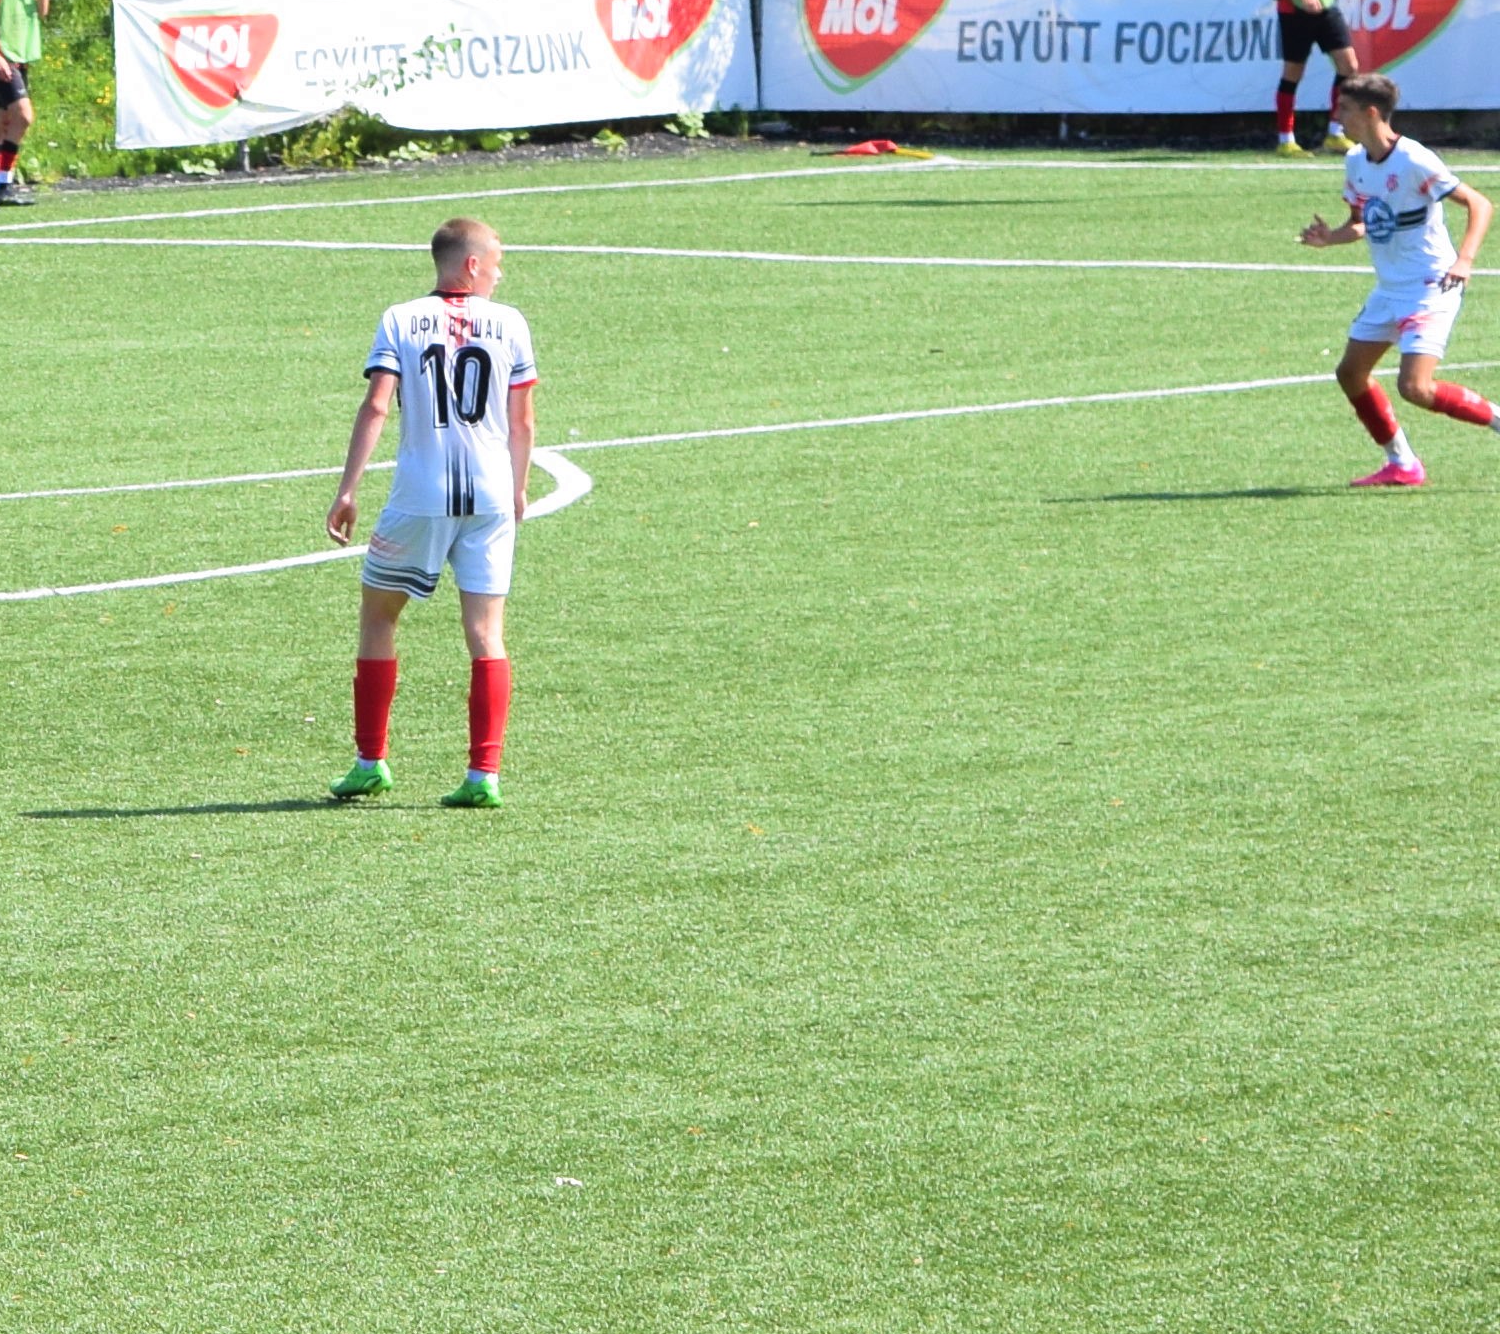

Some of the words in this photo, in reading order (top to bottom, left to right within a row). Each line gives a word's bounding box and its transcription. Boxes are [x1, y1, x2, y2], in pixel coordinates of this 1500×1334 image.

[174, 23, 251, 69] MOL
[957, 10, 1101, 64] EGYÜTT
[1113, 18, 1284, 64] FOCIZUN
[411, 315, 439, 335] ОФК
[449, 316, 503, 343] ВРШАЦ
[420, 342, 492, 429] 10
